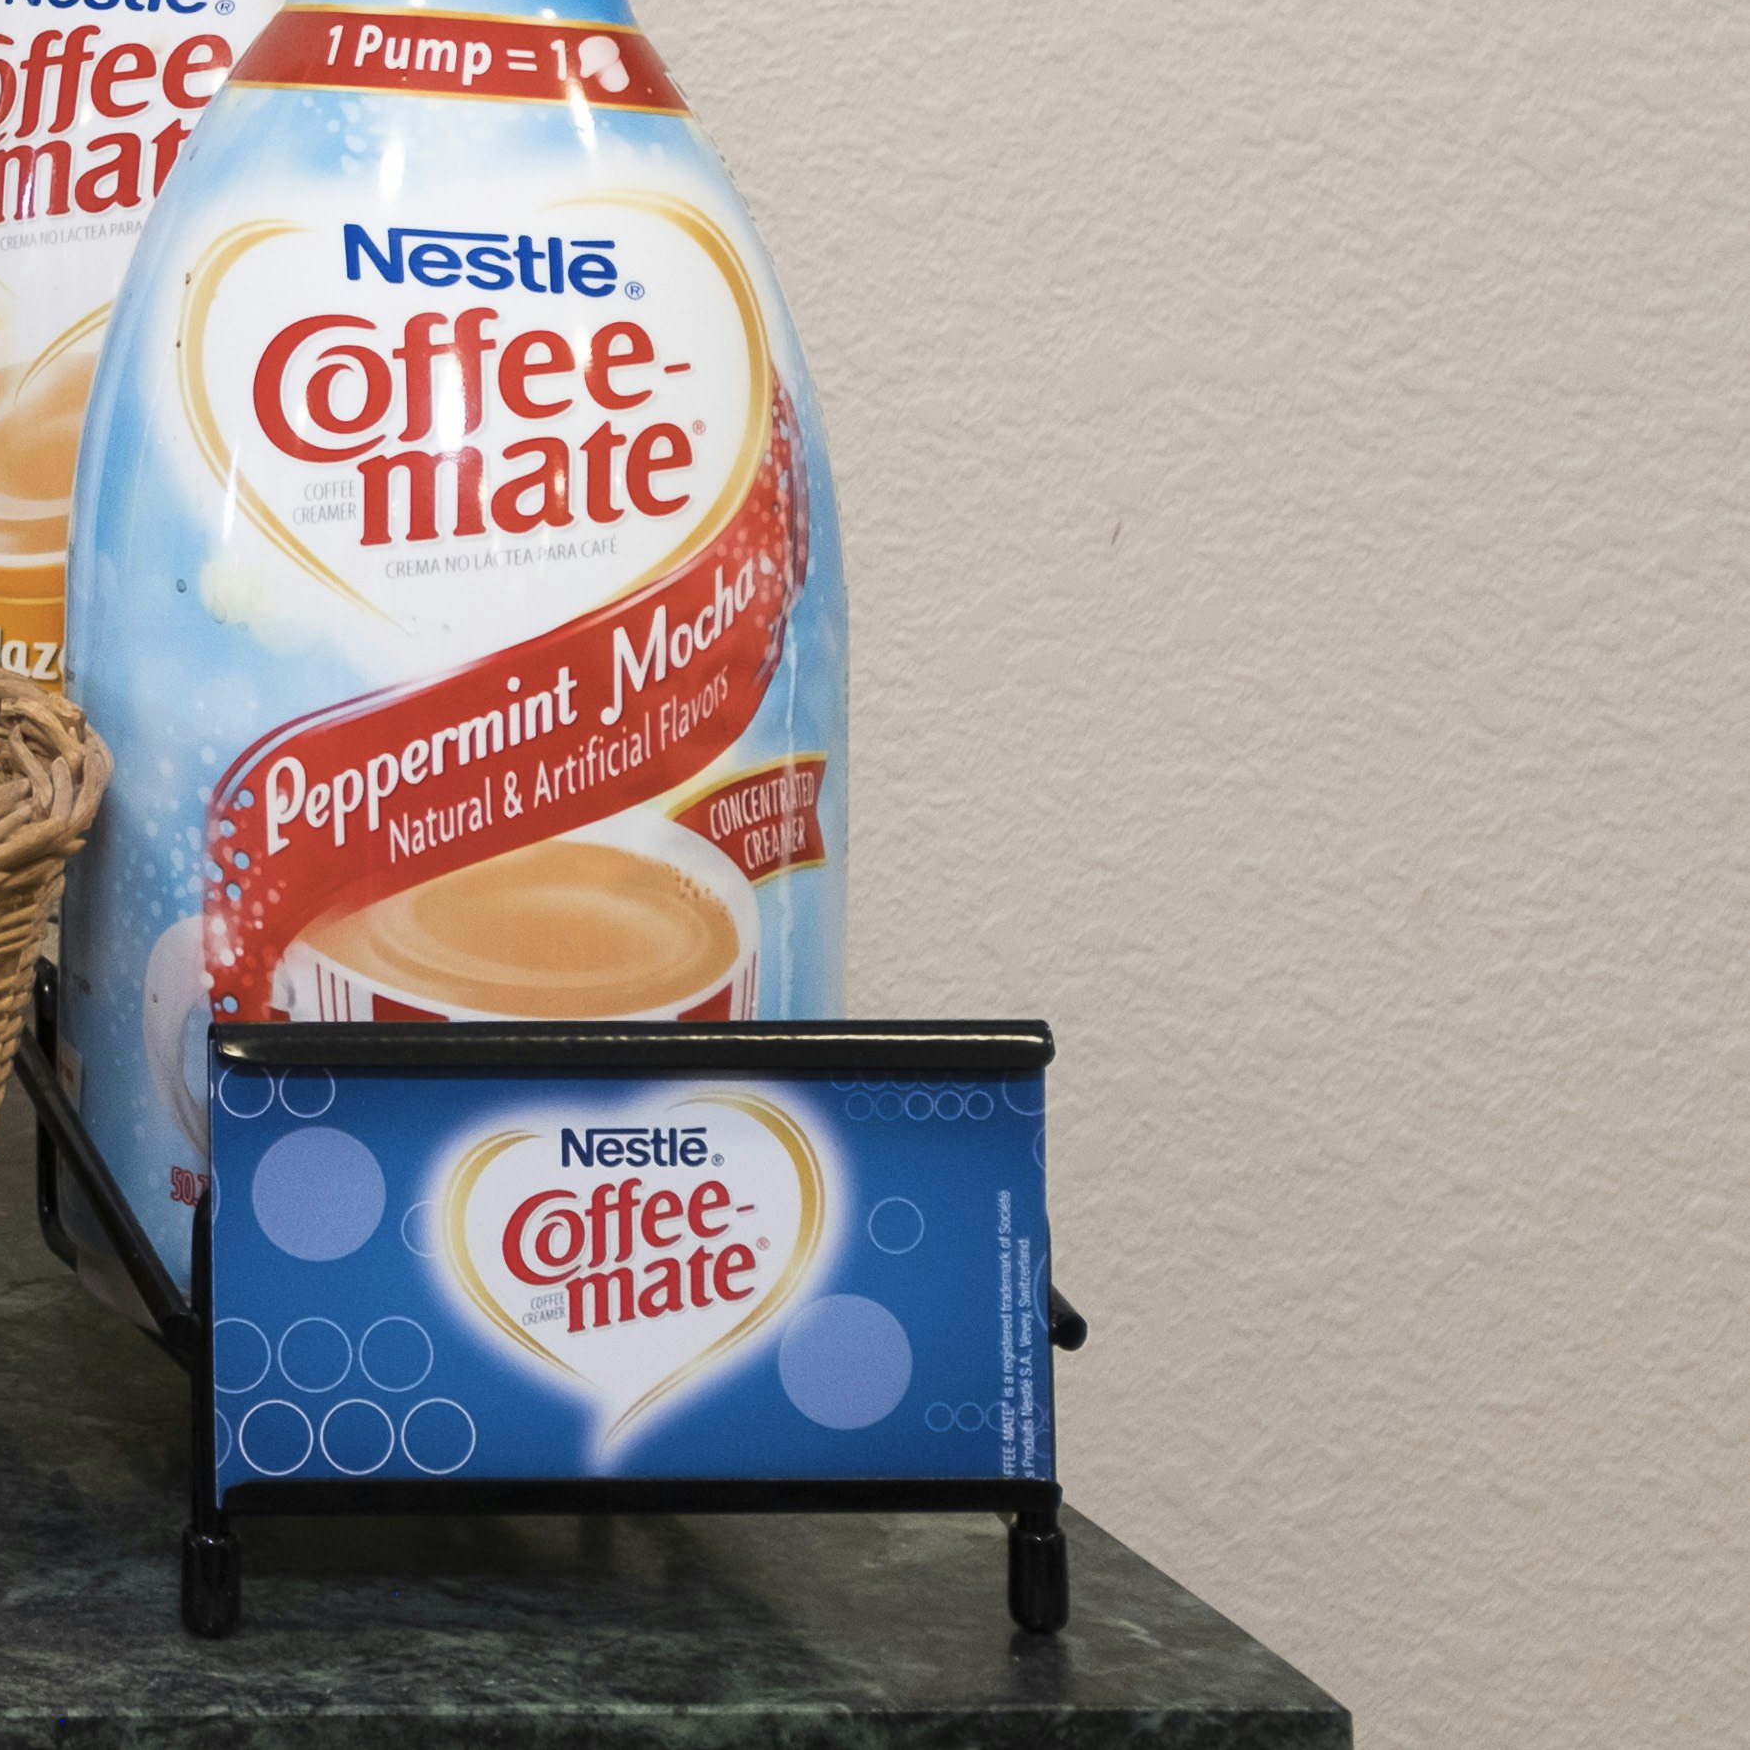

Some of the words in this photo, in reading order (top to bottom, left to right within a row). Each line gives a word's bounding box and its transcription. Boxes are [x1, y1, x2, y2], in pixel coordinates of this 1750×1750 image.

[326, 24, 345, 66] 1
[354, 23, 493, 86] Pump
[550, 39, 568, 81] 1
[0, 234, 37, 251] CREMA
[40, 229, 58, 245] NO
[110, 220, 143, 237] PARA
[253, 306, 691, 464] Coffee-
[292, 501, 357, 526] CREAMER
[304, 479, 357, 501] COFFEE
[357, 421, 693, 547] mate
[385, 553, 441, 579] CREMA
[445, 552, 470, 572] NO
[538, 543, 577, 563] PARA
[581, 534, 618, 558] CAFÉ
[265, 666, 578, 856] Peppermint
[600, 556, 757, 727] Mocha
[389, 777, 494, 863] Natural
[503, 771, 523, 819] &
[533, 711, 652, 807] Artificial
[659, 665, 729, 752] Flavors
[709, 771, 816, 841] CONCENTRATED
[743, 815, 807, 871] CREAMER
[502, 1177, 755, 1286] Coffee-
[997, 1236, 1012, 1249] of
[530, 1292, 565, 1310] COFFEE
[565, 1243, 756, 1333] mate
[999, 1251, 1013, 1312] trademark
[522, 1307, 566, 1327] CREAMER
[1000, 1314, 1016, 1374] registered
